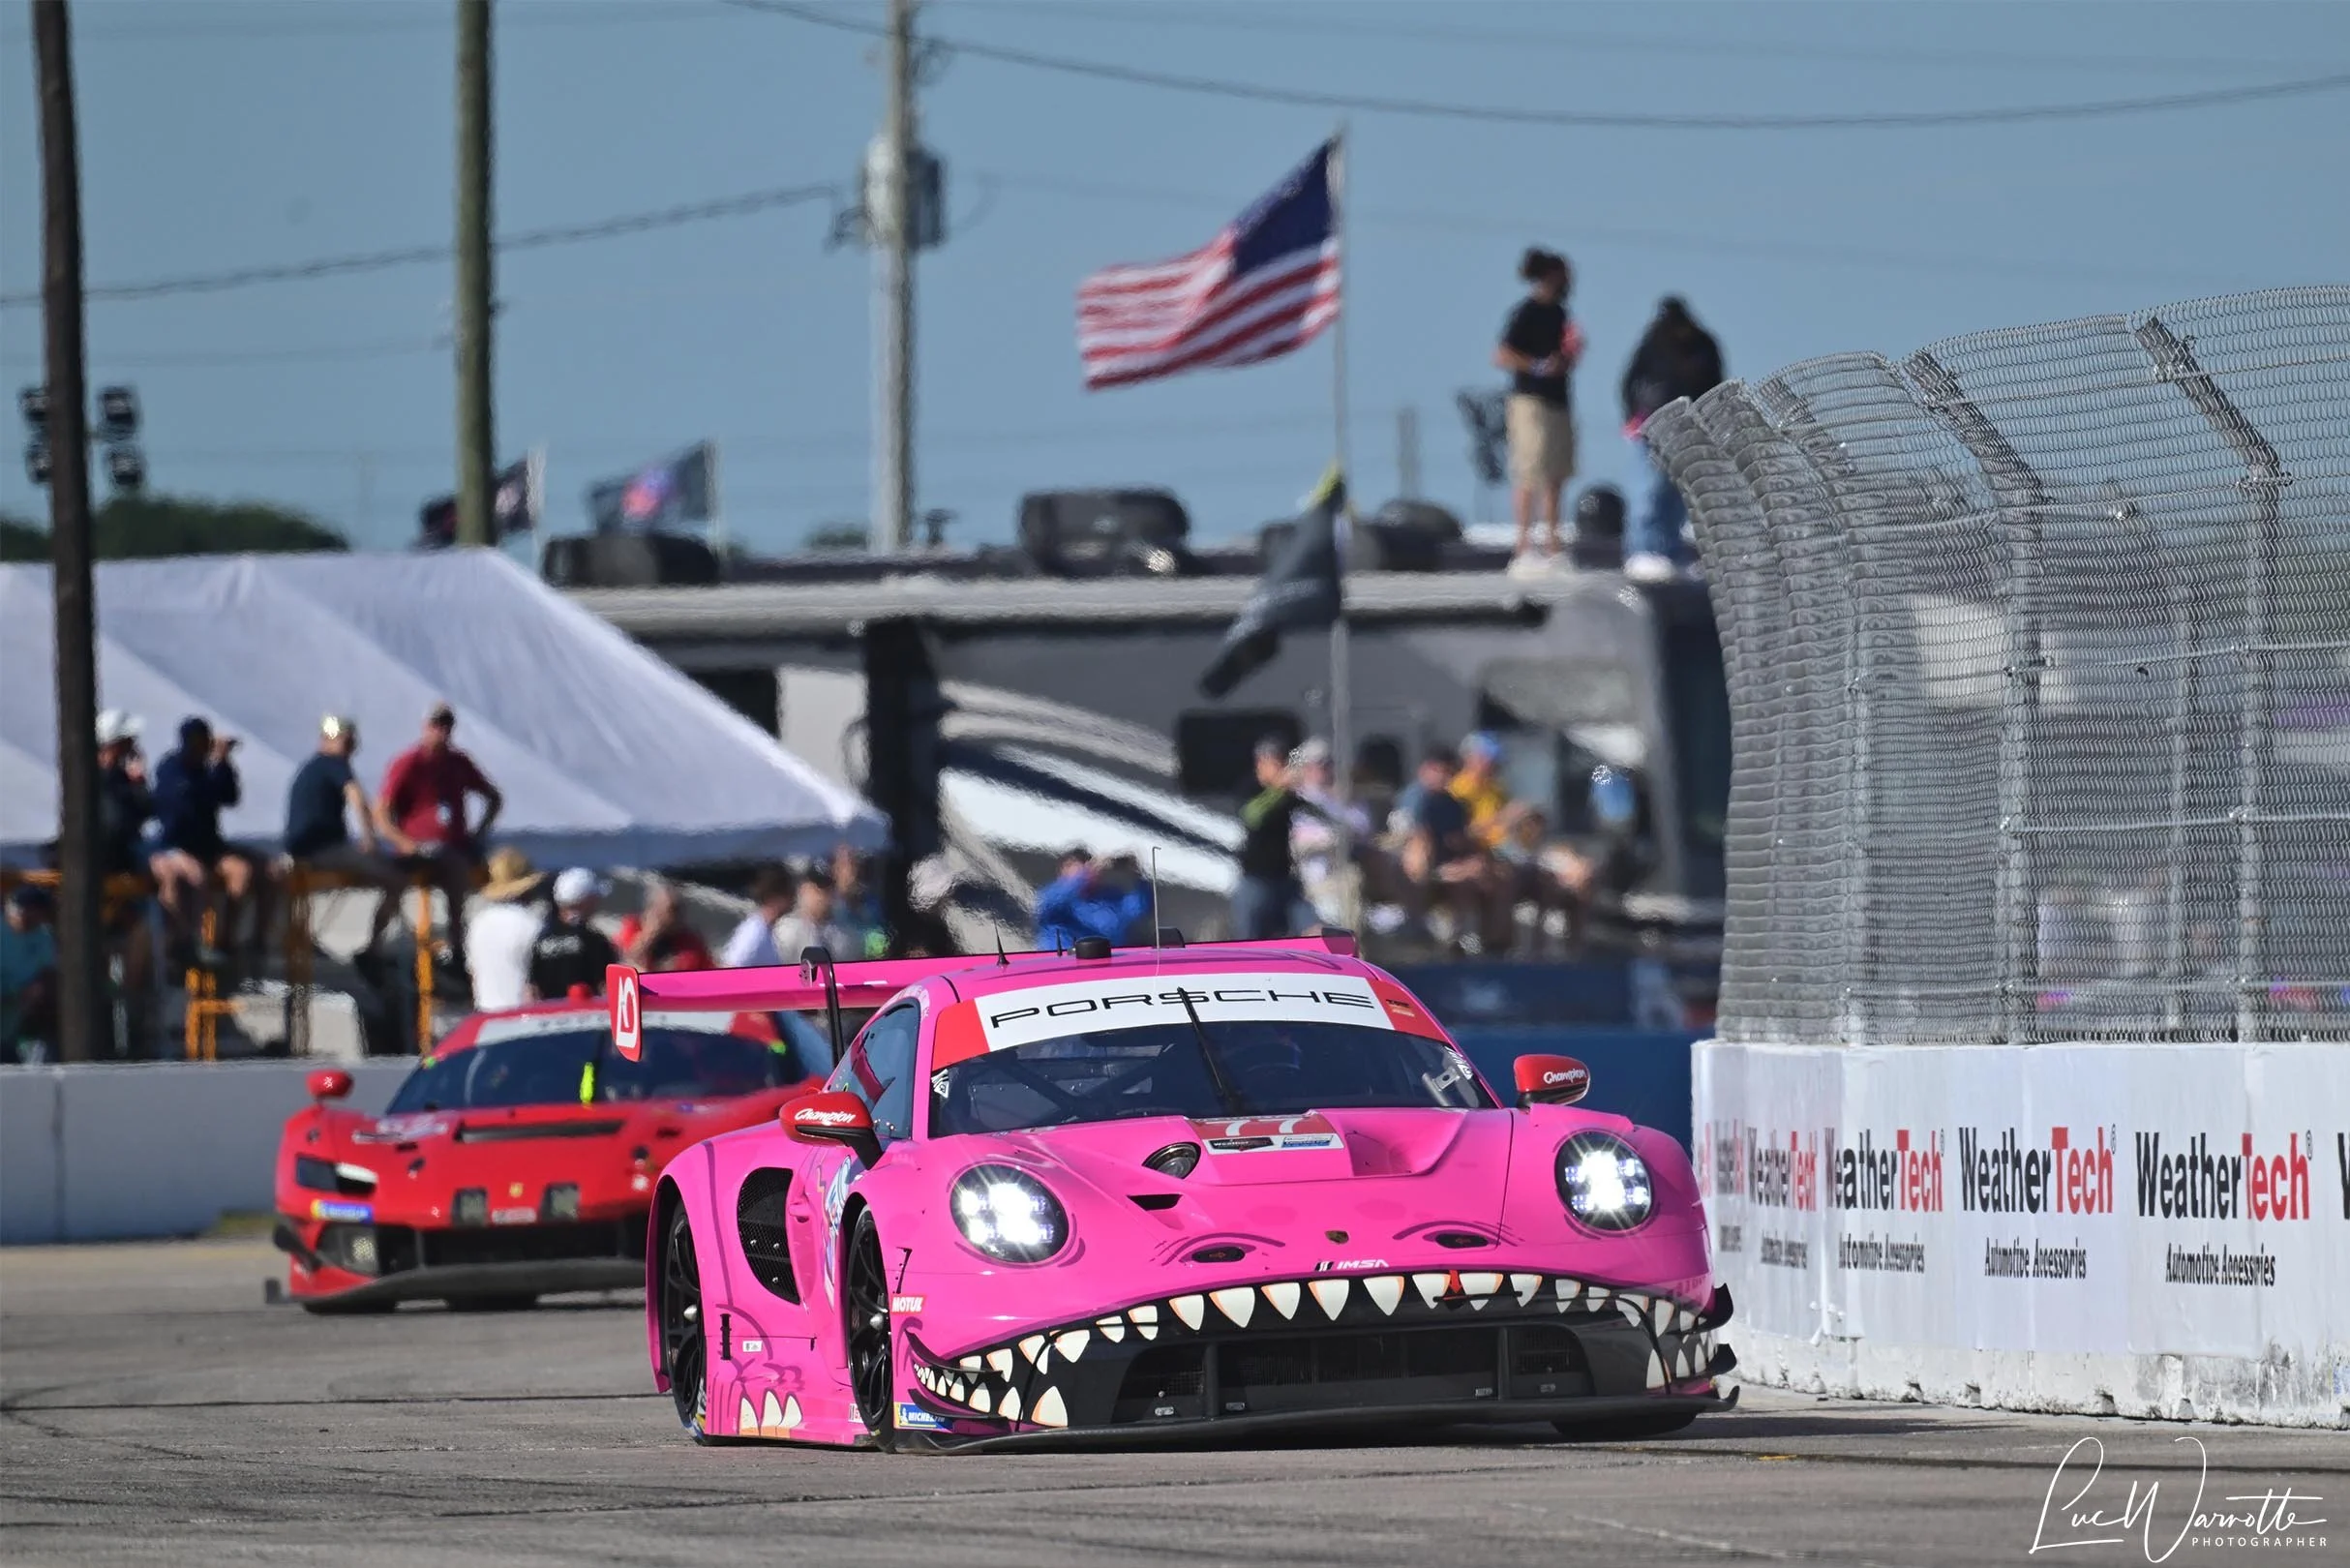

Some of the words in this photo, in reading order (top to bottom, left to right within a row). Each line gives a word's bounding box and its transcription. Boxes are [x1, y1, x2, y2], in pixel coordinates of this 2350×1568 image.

[991, 988, 1374, 1029] PORSCHE
[1543, 1069, 1586, 1084] Champion
[795, 1108, 856, 1126] Champion
[1959, 1127, 2114, 1214] WeatherTech
[2135, 1131, 2310, 1221] WeatherTech
[1337, 1259, 1389, 1270] IMSA
[1985, 1237, 2030, 1279] Automotive
[2033, 1237, 2087, 1279] Accessories
[2165, 1243, 2219, 1284] Automotive
[891, 1297, 922, 1312] MOTUL
